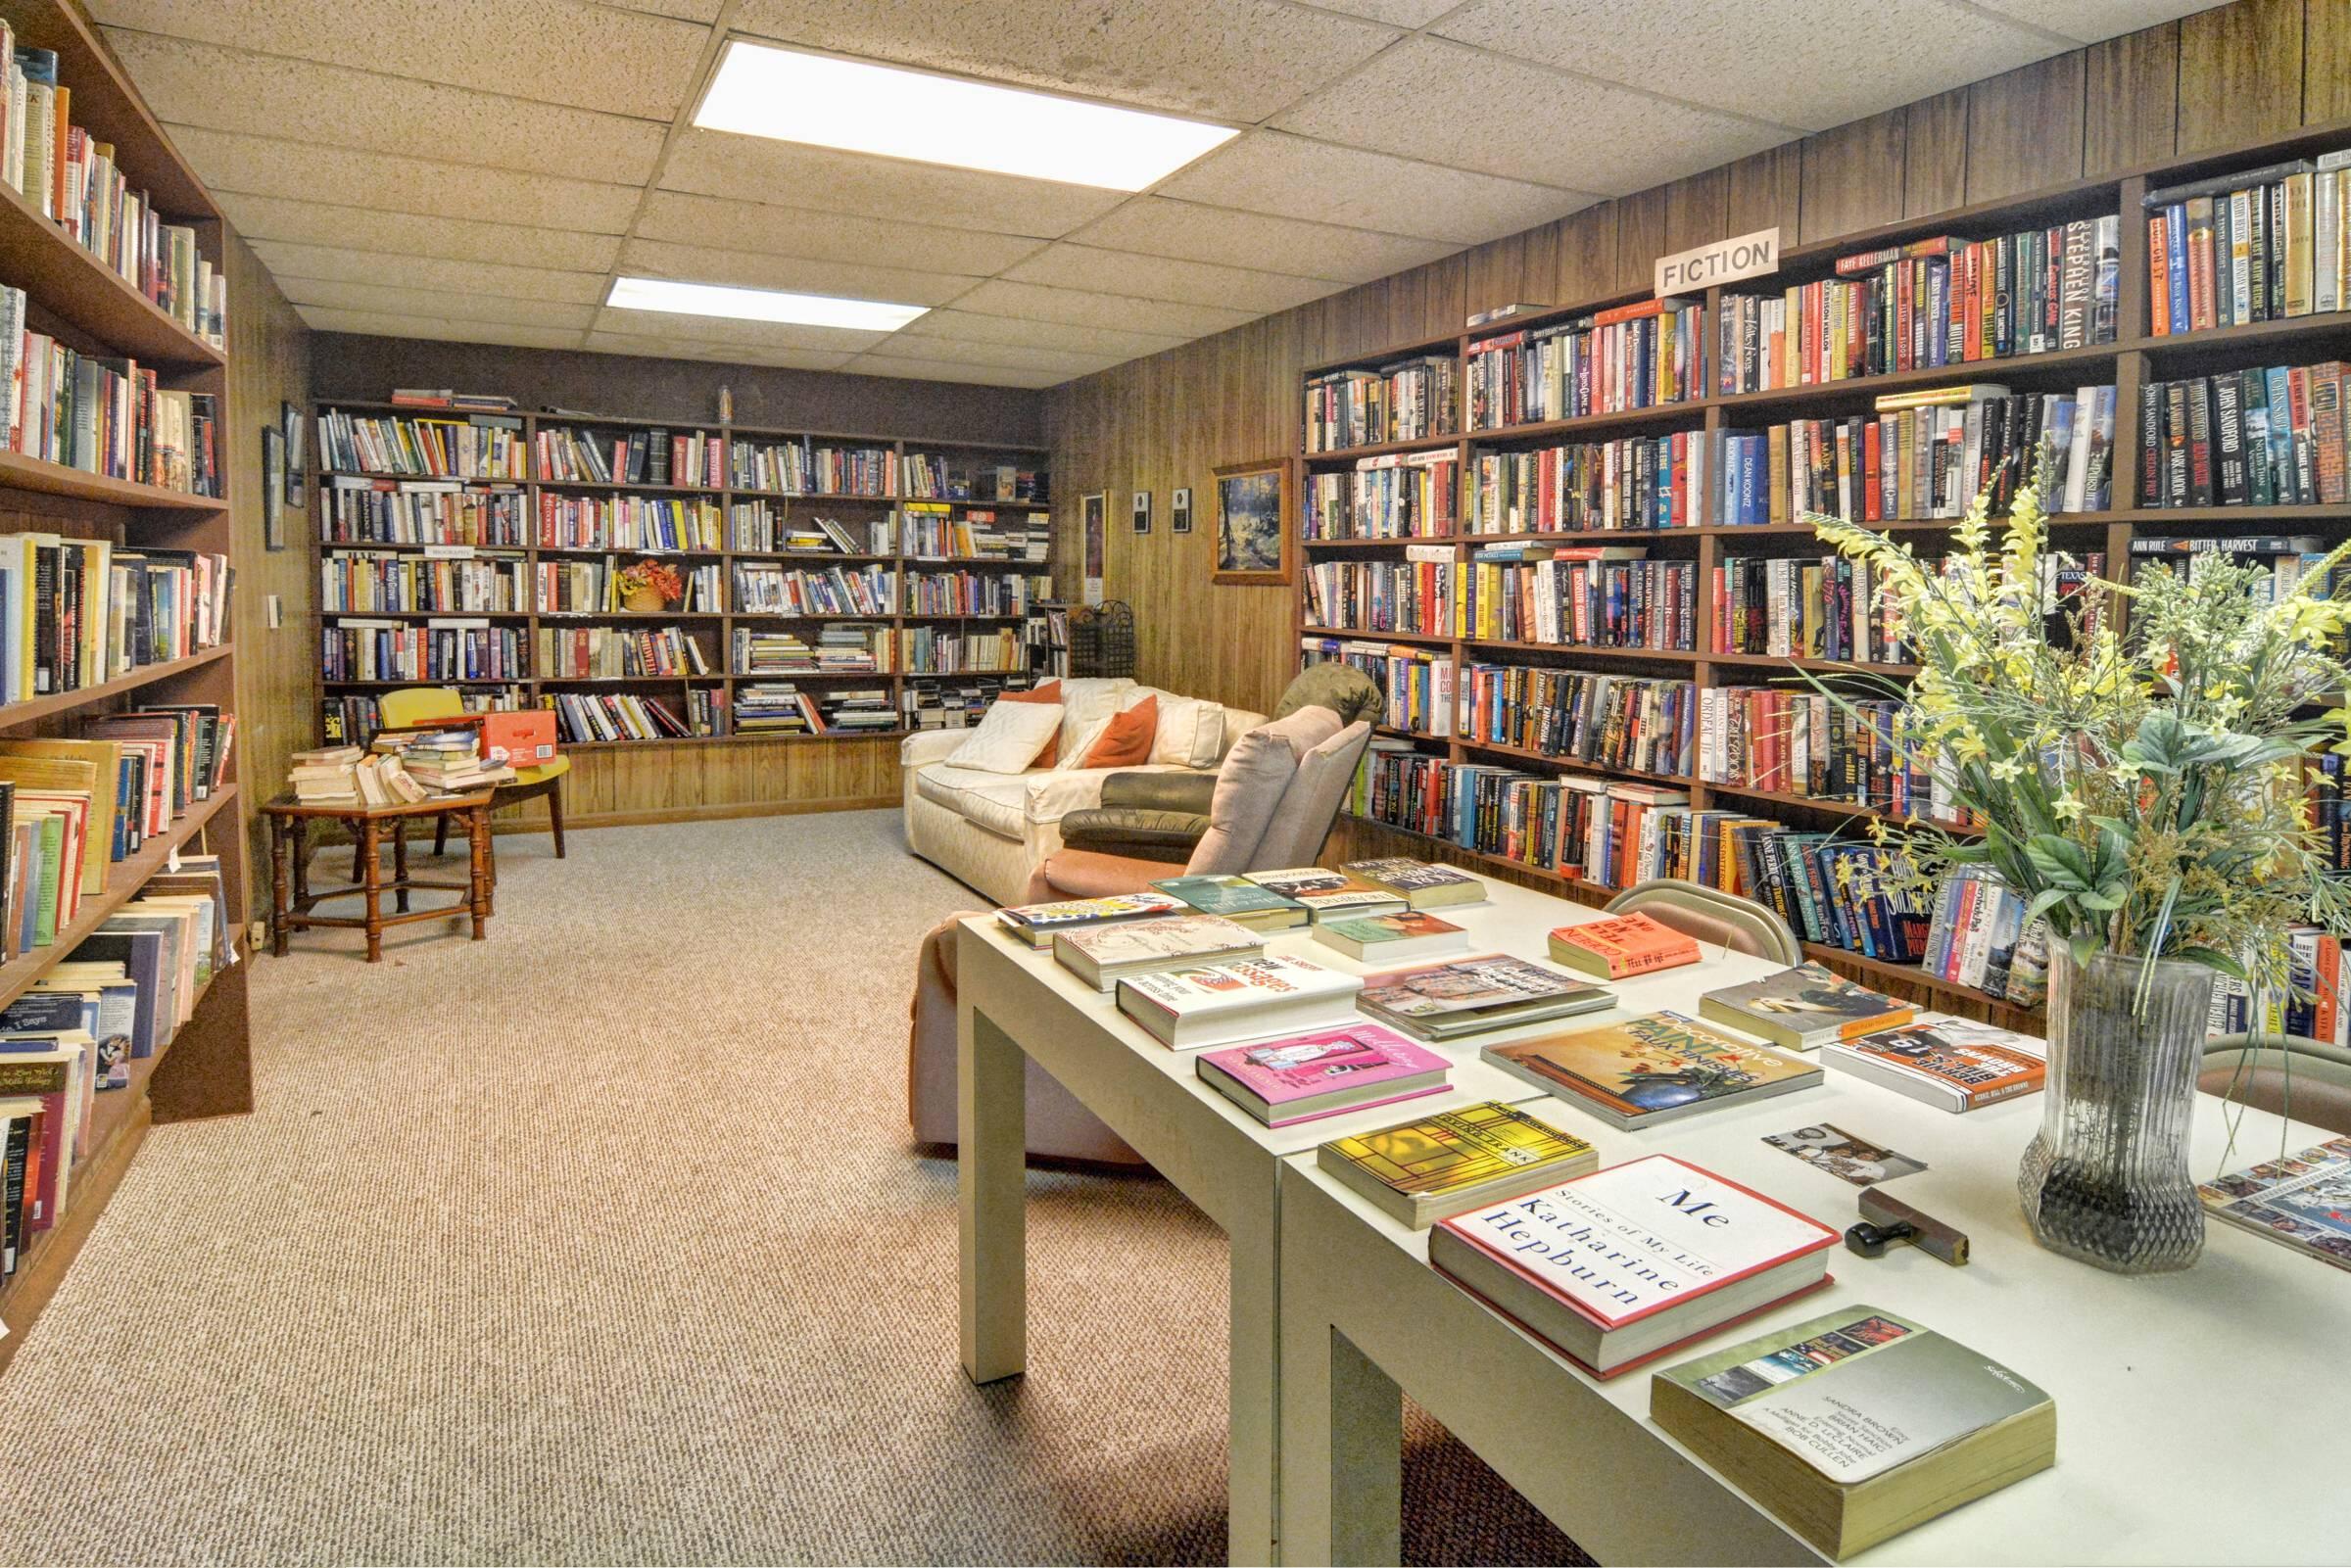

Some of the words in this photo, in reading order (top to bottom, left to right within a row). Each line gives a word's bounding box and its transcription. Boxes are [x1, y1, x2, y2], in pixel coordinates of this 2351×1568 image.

[2217, 203, 2226, 216] THE
[2274, 189, 2282, 222] KATHY
[2151, 221, 2162, 246] DOG
[2217, 218, 2226, 241] TENTH
[2252, 239, 2263, 257] LOST
[2274, 225, 2282, 261] REICHS
[1663, 241, 1769, 287] FICTION
[1840, 257, 1856, 273] FAYE
[1858, 247, 1899, 267] KELLERMAN
[2064, 220, 2087, 303] STEPHEN
[2079, 223, 2092, 303] DESPERATION
[2217, 242, 2227, 270] INSIGHT
[2252, 260, 2264, 283] KATHY
[1823, 281, 1832, 320] GARRISON
[2252, 284, 2264, 309] REICHS
[1746, 320, 1758, 348] Valley
[1949, 323, 1962, 354] MOTIVE
[1984, 313, 1995, 346] THERAPY
[2062, 308, 2083, 351] KING
[1744, 347, 1758, 374] Forge
[2292, 371, 2302, 382] THE
[2146, 384, 2159, 406] JOHN
[2189, 383, 2204, 404] JOHN
[2220, 387, 2235, 410] JOHN
[2272, 375, 2286, 405] JOHN
[2294, 383, 2304, 404] ENEMY
[1985, 404, 1995, 419] JOHN
[2027, 397, 2038, 415] JOHN
[2295, 404, 2305, 426] WITHIN
[2145, 406, 2157, 447] SANDFORD
[2169, 404, 2184, 437] SANDFORD
[2191, 403, 2207, 441] SANDFORD
[2221, 409, 2239, 453] SANDFORD
[1659, 443, 1668, 454] THE
[1726, 441, 1738, 473] KOONTZ
[1820, 442, 1832, 471] MARK
[2256, 439, 2265, 450] NO
[2297, 442, 2308, 467] MICHAEL
[1659, 455, 1668, 471] EDGE
[1744, 456, 1754, 478] DEAN
[2146, 447, 2157, 477] CERTAIN
[2171, 449, 2185, 468] DARK
[2255, 451, 2265, 466] LESS
[2085, 466, 2099, 501] PURSUIT
[2146, 479, 2157, 498] PREY
[2171, 473, 2185, 497] MOON
[2256, 466, 2266, 487] THAN
[2300, 467, 2310, 490] SAVAGE
[1743, 478, 1753, 508] KOONTZ
[2133, 541, 2147, 551] ANN
[2148, 540, 2167, 551] RULE
[2189, 540, 2217, 551] BITTER
[2221, 539, 2258, 551] HARVEST
[2060, 571, 2088, 581] TEXAS
[2279, 564, 2292, 596] WILBUR
[1824, 579, 1836, 605] 1776
[1702, 696, 1715, 737] ORDEAL
[1717, 699, 1726, 731] DEVIANT
[1716, 733, 1725, 753] WAYS
[1762, 835, 1774, 856] ANNE
[1786, 840, 1799, 863] ANNE
[1801, 845, 1814, 867] ANNE
[1765, 856, 1778, 876] PERRY
[1792, 863, 1806, 885] PERRY
[1806, 868, 1820, 890] PERRY
[1620, 918, 1655, 932] ONE
[1815, 904, 1826, 925] SILENT
[1589, 924, 1624, 944] TELL
[1604, 922, 1632, 934] NO
[1819, 926, 1831, 940] CRY
[1561, 928, 1622, 956] COBEN
[23, 1016, 48, 1027] Says
[1624, 1018, 1731, 1056] PAINT
[1655, 1017, 1783, 1068] Decorative
[1627, 1029, 1679, 1052] FAUX
[1674, 1048, 1760, 1084] FINISHES
[1485, 1138, 1529, 1163] FRANK
[1655, 1188, 1732, 1229] Me
[1518, 1198, 1680, 1291] Katharine
[1554, 1189, 1615, 1224] Stories
[1616, 1223, 1644, 1236] of
[1640, 1235, 1669, 1255] My
[1662, 1253, 1714, 1277] Life
[1480, 1210, 1640, 1306] Hepburn
[1781, 1407, 1804, 1423] ANNE
[1821, 1396, 1863, 1418] SANDRA
[1862, 1417, 1905, 1446] BROWN
[1827, 1414, 1859, 1435] BRIAN
[1859, 1429, 1887, 1453] HAIG
[1847, 1435, 1877, 1457] Normal
[1785, 1424, 1809, 1443] BOB
[1808, 1437, 1850, 1469] CULLEN
